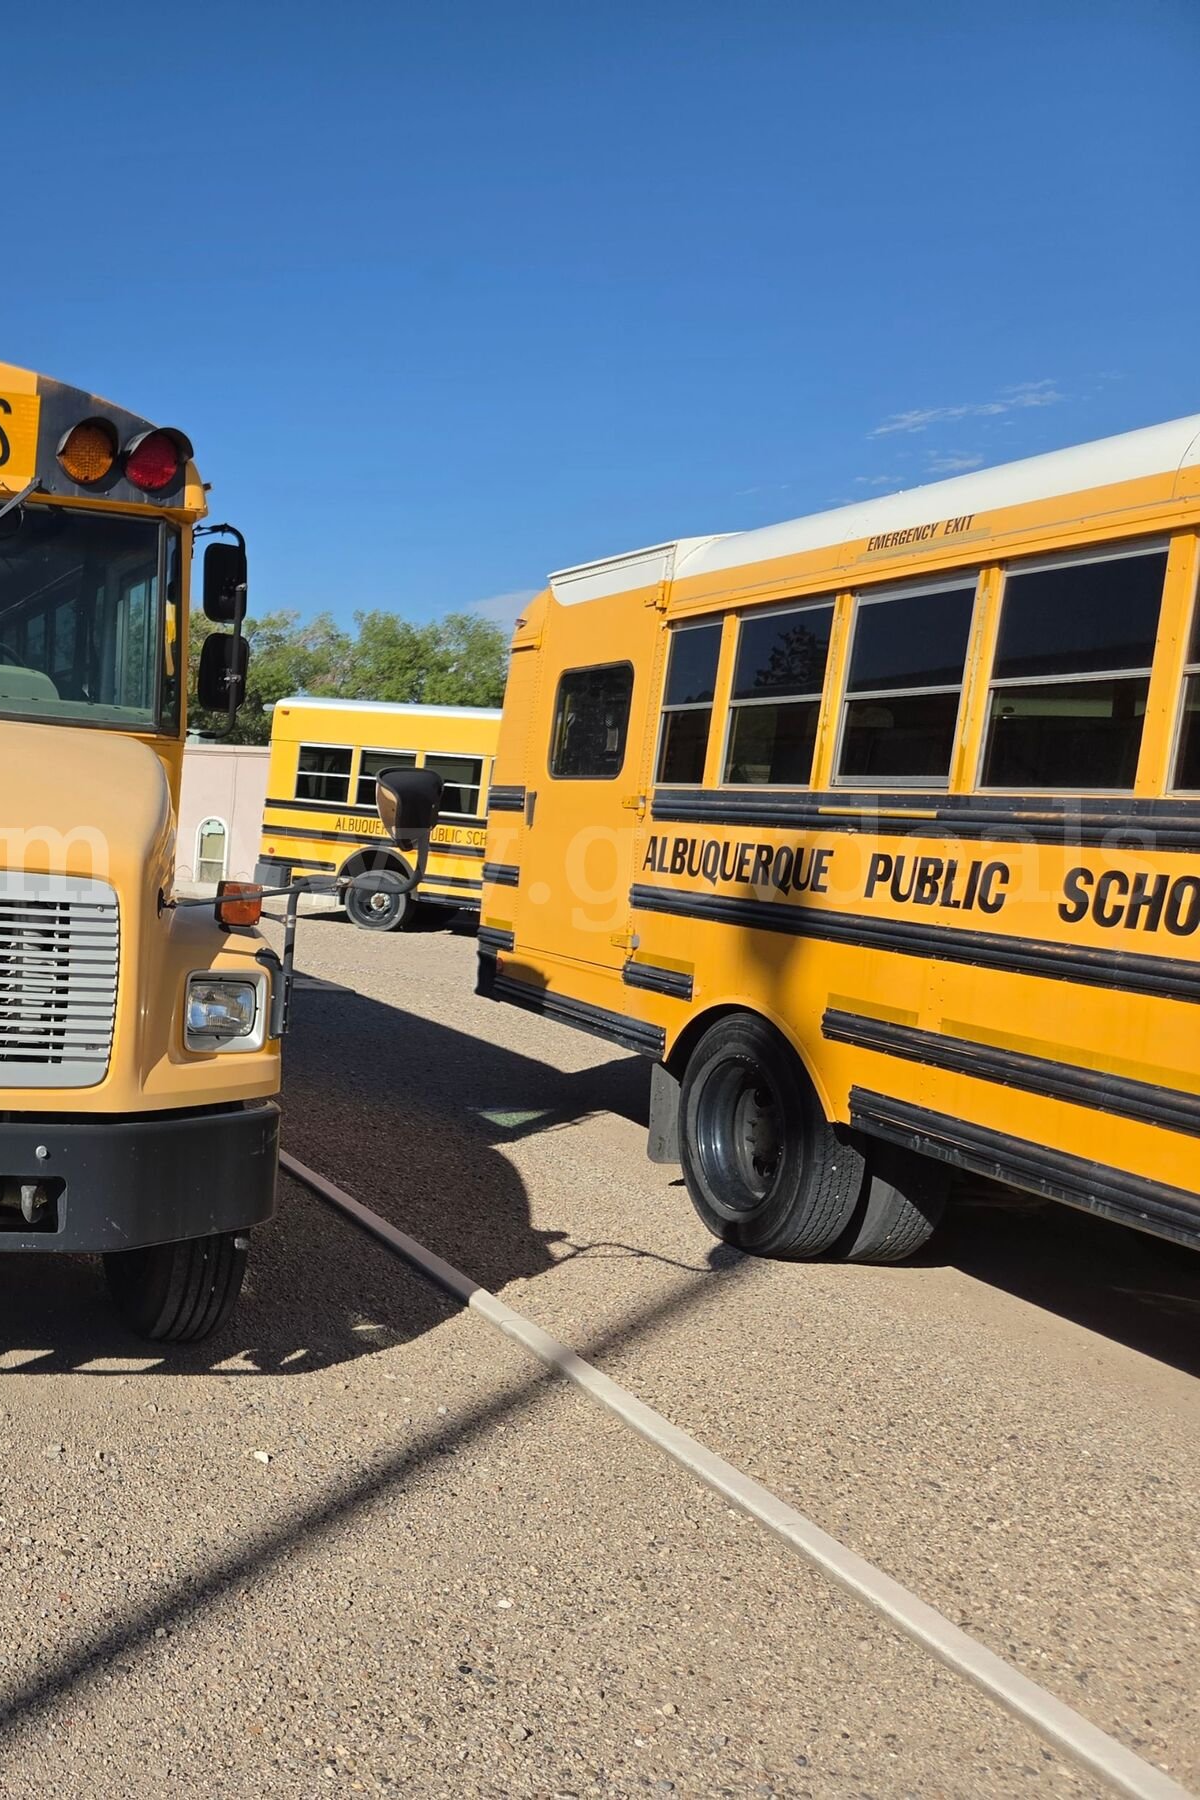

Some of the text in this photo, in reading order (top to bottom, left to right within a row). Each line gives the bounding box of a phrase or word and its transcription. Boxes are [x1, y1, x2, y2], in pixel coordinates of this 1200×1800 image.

[866, 514, 976, 552] EMERGENCY EXIT
[430, 825, 463, 844] UBLIC
[641, 835, 1200, 937] ALBUQUERQUE PUBLIC SCHO
